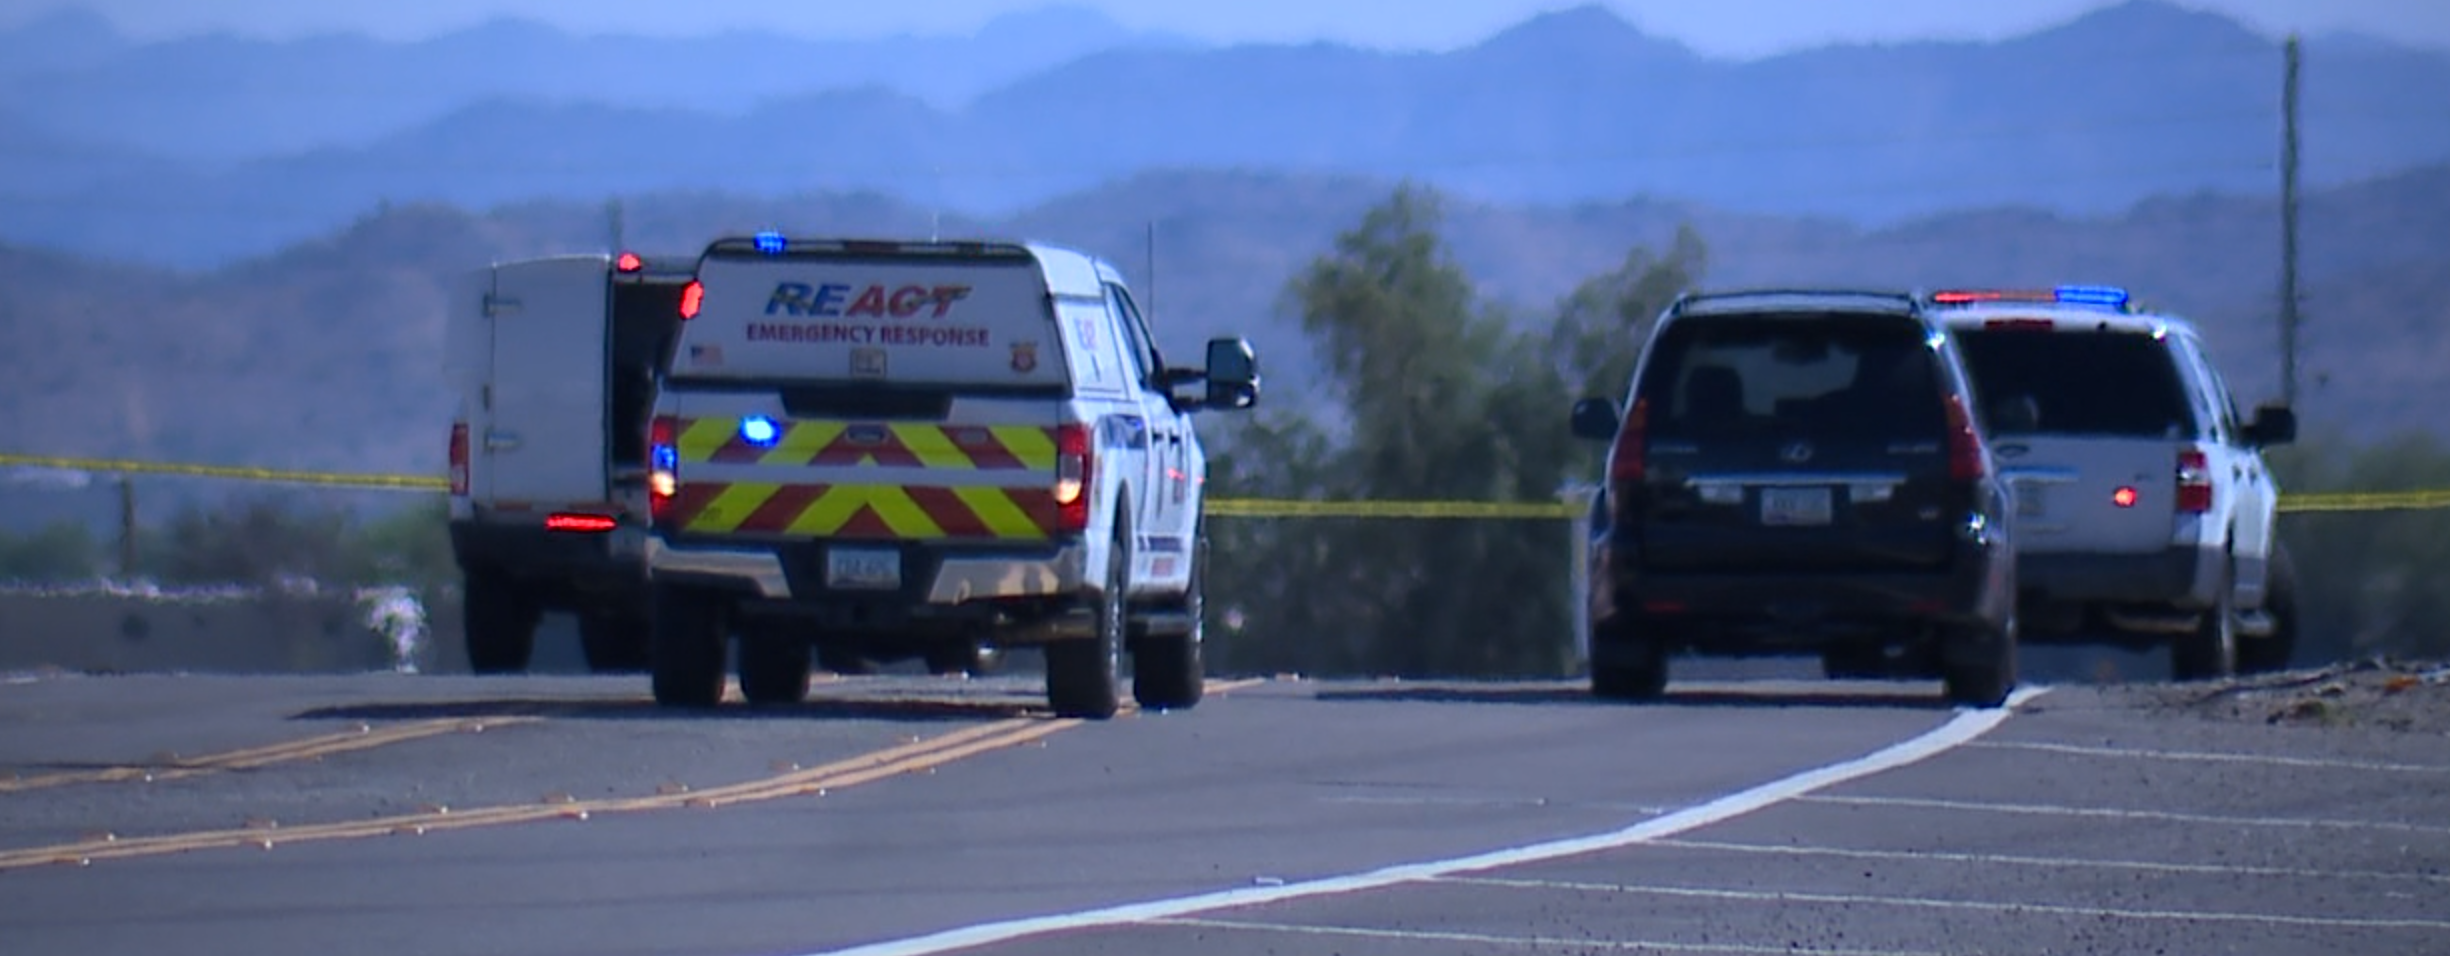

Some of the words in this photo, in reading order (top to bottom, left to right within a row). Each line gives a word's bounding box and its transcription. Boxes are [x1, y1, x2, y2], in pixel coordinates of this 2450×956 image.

[765, 282, 972, 318] REACT
[747, 322, 876, 345] EMERGENCY
[880, 325, 990, 348] RESPONSE
